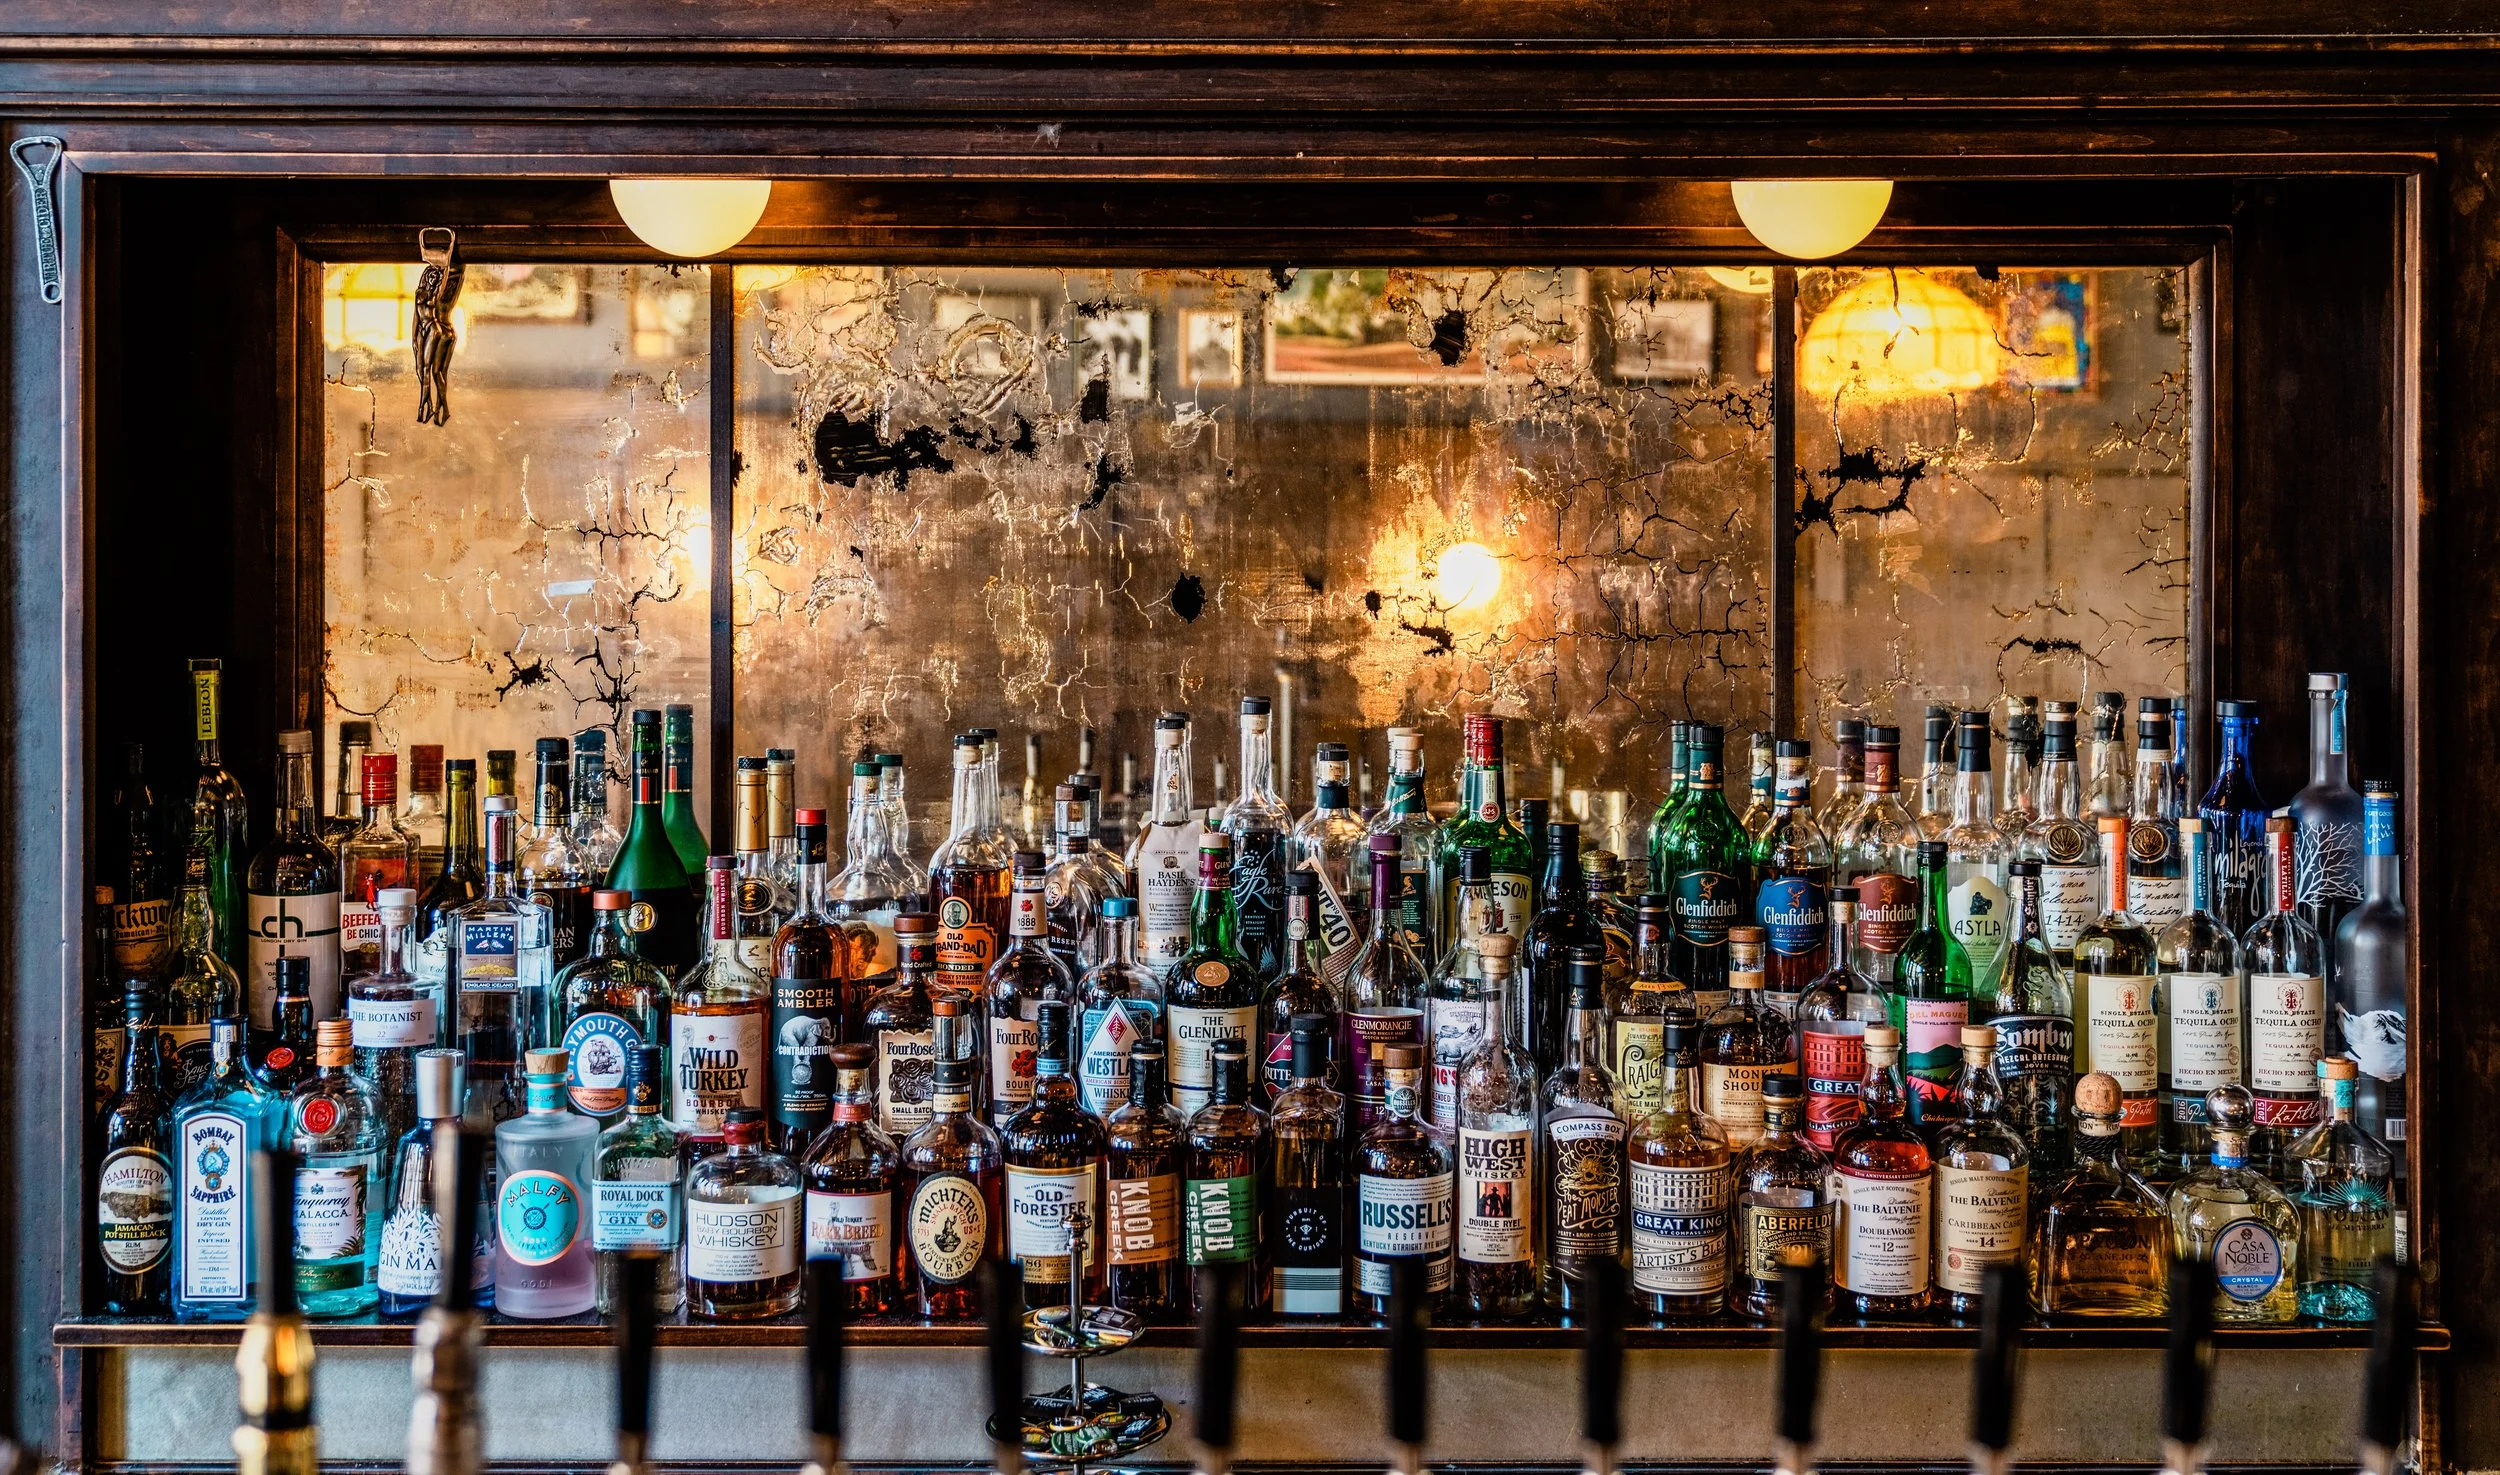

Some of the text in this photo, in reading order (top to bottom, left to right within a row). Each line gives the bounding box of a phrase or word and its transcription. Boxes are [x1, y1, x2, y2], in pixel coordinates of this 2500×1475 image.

[36, 190, 57, 283] VIRTUE CIDER
[202, 678, 212, 734] LEBLON
[2281, 850, 2288, 862] LA
[1158, 871, 1186, 879] BASIL
[1148, 878, 1196, 886] HAYDEN'S
[2221, 879, 2246, 889] Tequila
[1676, 897, 1737, 917] Glenfiddich
[1858, 904, 1917, 922] Glenfiddich
[1017, 917, 1036, 927] 1888
[1764, 906, 1824, 926] Glenfiddich
[1954, 919, 2001, 936] ASYLA
[466, 933, 513, 942] MILLER'S
[947, 933, 964, 941] OLD
[937, 963, 974, 971] BONDED
[778, 988, 834, 997] SMOOTH
[352, 1011, 423, 1022] THE BOTANIST
[1698, 1005, 1711, 1017] 12
[1930, 1011, 1967, 1019] MAGUEY
[1202, 1016, 1224, 1026] THE
[1351, 1018, 1412, 1030] GLENMORANGIE
[2092, 1018, 2156, 1027] TEQUILA OCHO
[2174, 1017, 2218, 1026] TEQUILA
[2254, 1018, 2322, 1026] TEQUILA OCHO
[996, 1028, 1021, 1044] Four
[1179, 1025, 1246, 1039] GLENLIVET
[779, 1045, 833, 1056] CONTRADICTION
[886, 1042, 906, 1055] Four
[689, 1047, 738, 1069] WILD
[1999, 1054, 2030, 1064] MEZCAL
[686, 1098, 740, 1107] BOURBON
[2178, 1101, 2186, 1120] 2016
[2258, 1101, 2266, 1121] 2015
[1556, 1123, 1621, 1134] COMPASS BOX
[192, 1126, 236, 1146] BOMBAY
[1464, 1137, 1527, 1157] HIGH
[1464, 1157, 1527, 1169] WEST
[104, 1168, 168, 1186] HAMILTON
[1464, 1169, 1527, 1179] WHISKEY
[190, 1185, 237, 1203] SAPPHIRE
[505, 1180, 571, 1207] MALFY
[601, 1190, 664, 1201] ROYAL DOCK
[1034, 1189, 1063, 1202] OLD
[1853, 1188, 1869, 1196] SINGLE
[1904, 1188, 1921, 1196] WHISKY
[919, 1188, 980, 1225] MICHTER'S
[1556, 1188, 1619, 1226] PEAT MONSTER
[1949, 1195, 2021, 1207] THE BALVENIE
[1013, 1199, 1086, 1216] FORESTER
[1362, 1197, 1452, 1230] RUSSELL'S
[1853, 1204, 1922, 1214] THE BALVENIE
[2322, 1206, 2390, 1221] VOLCAN
[609, 1216, 639, 1225] GIN
[696, 1211, 778, 1227] HUDSON
[1119, 1181, 1154, 1250] KNOB
[1199, 1182, 1233, 1251] KNOB
[1757, 1212, 1833, 1230] ABERFELDY
[1110, 1190, 1124, 1261] CREEK
[1189, 1191, 1203, 1262] CREEK
[1469, 1218, 1500, 1228] DOUBLE
[1636, 1214, 1722, 1230] GREAT KING
[1948, 1218, 2021, 1229] CARIBBEAN CASK
[105, 1229, 166, 1239] POT STILL BLACK
[114, 1224, 154, 1233] JAMAICAN
[696, 1225, 778, 1235] BABY BOURBON
[811, 1224, 884, 1241] RARE BREED
[698, 1234, 777, 1248] WHISKEY
[1387, 1232, 1436, 1240] RESERVE
[1979, 1237, 1995, 1247] 14
[1363, 1240, 1435, 1251] KENTUCKY STRAIGHT RYE
[1790, 1244, 1809, 1259] 21
[1882, 1241, 1894, 1253] 12
[2228, 1240, 2266, 1253] CASA
[918, 1241, 981, 1272] BOURBON
[2225, 1252, 2270, 1265] NOBLE
[1025, 1259, 1041, 1268] 86
[934, 1269, 963, 1278] WHISKEY
